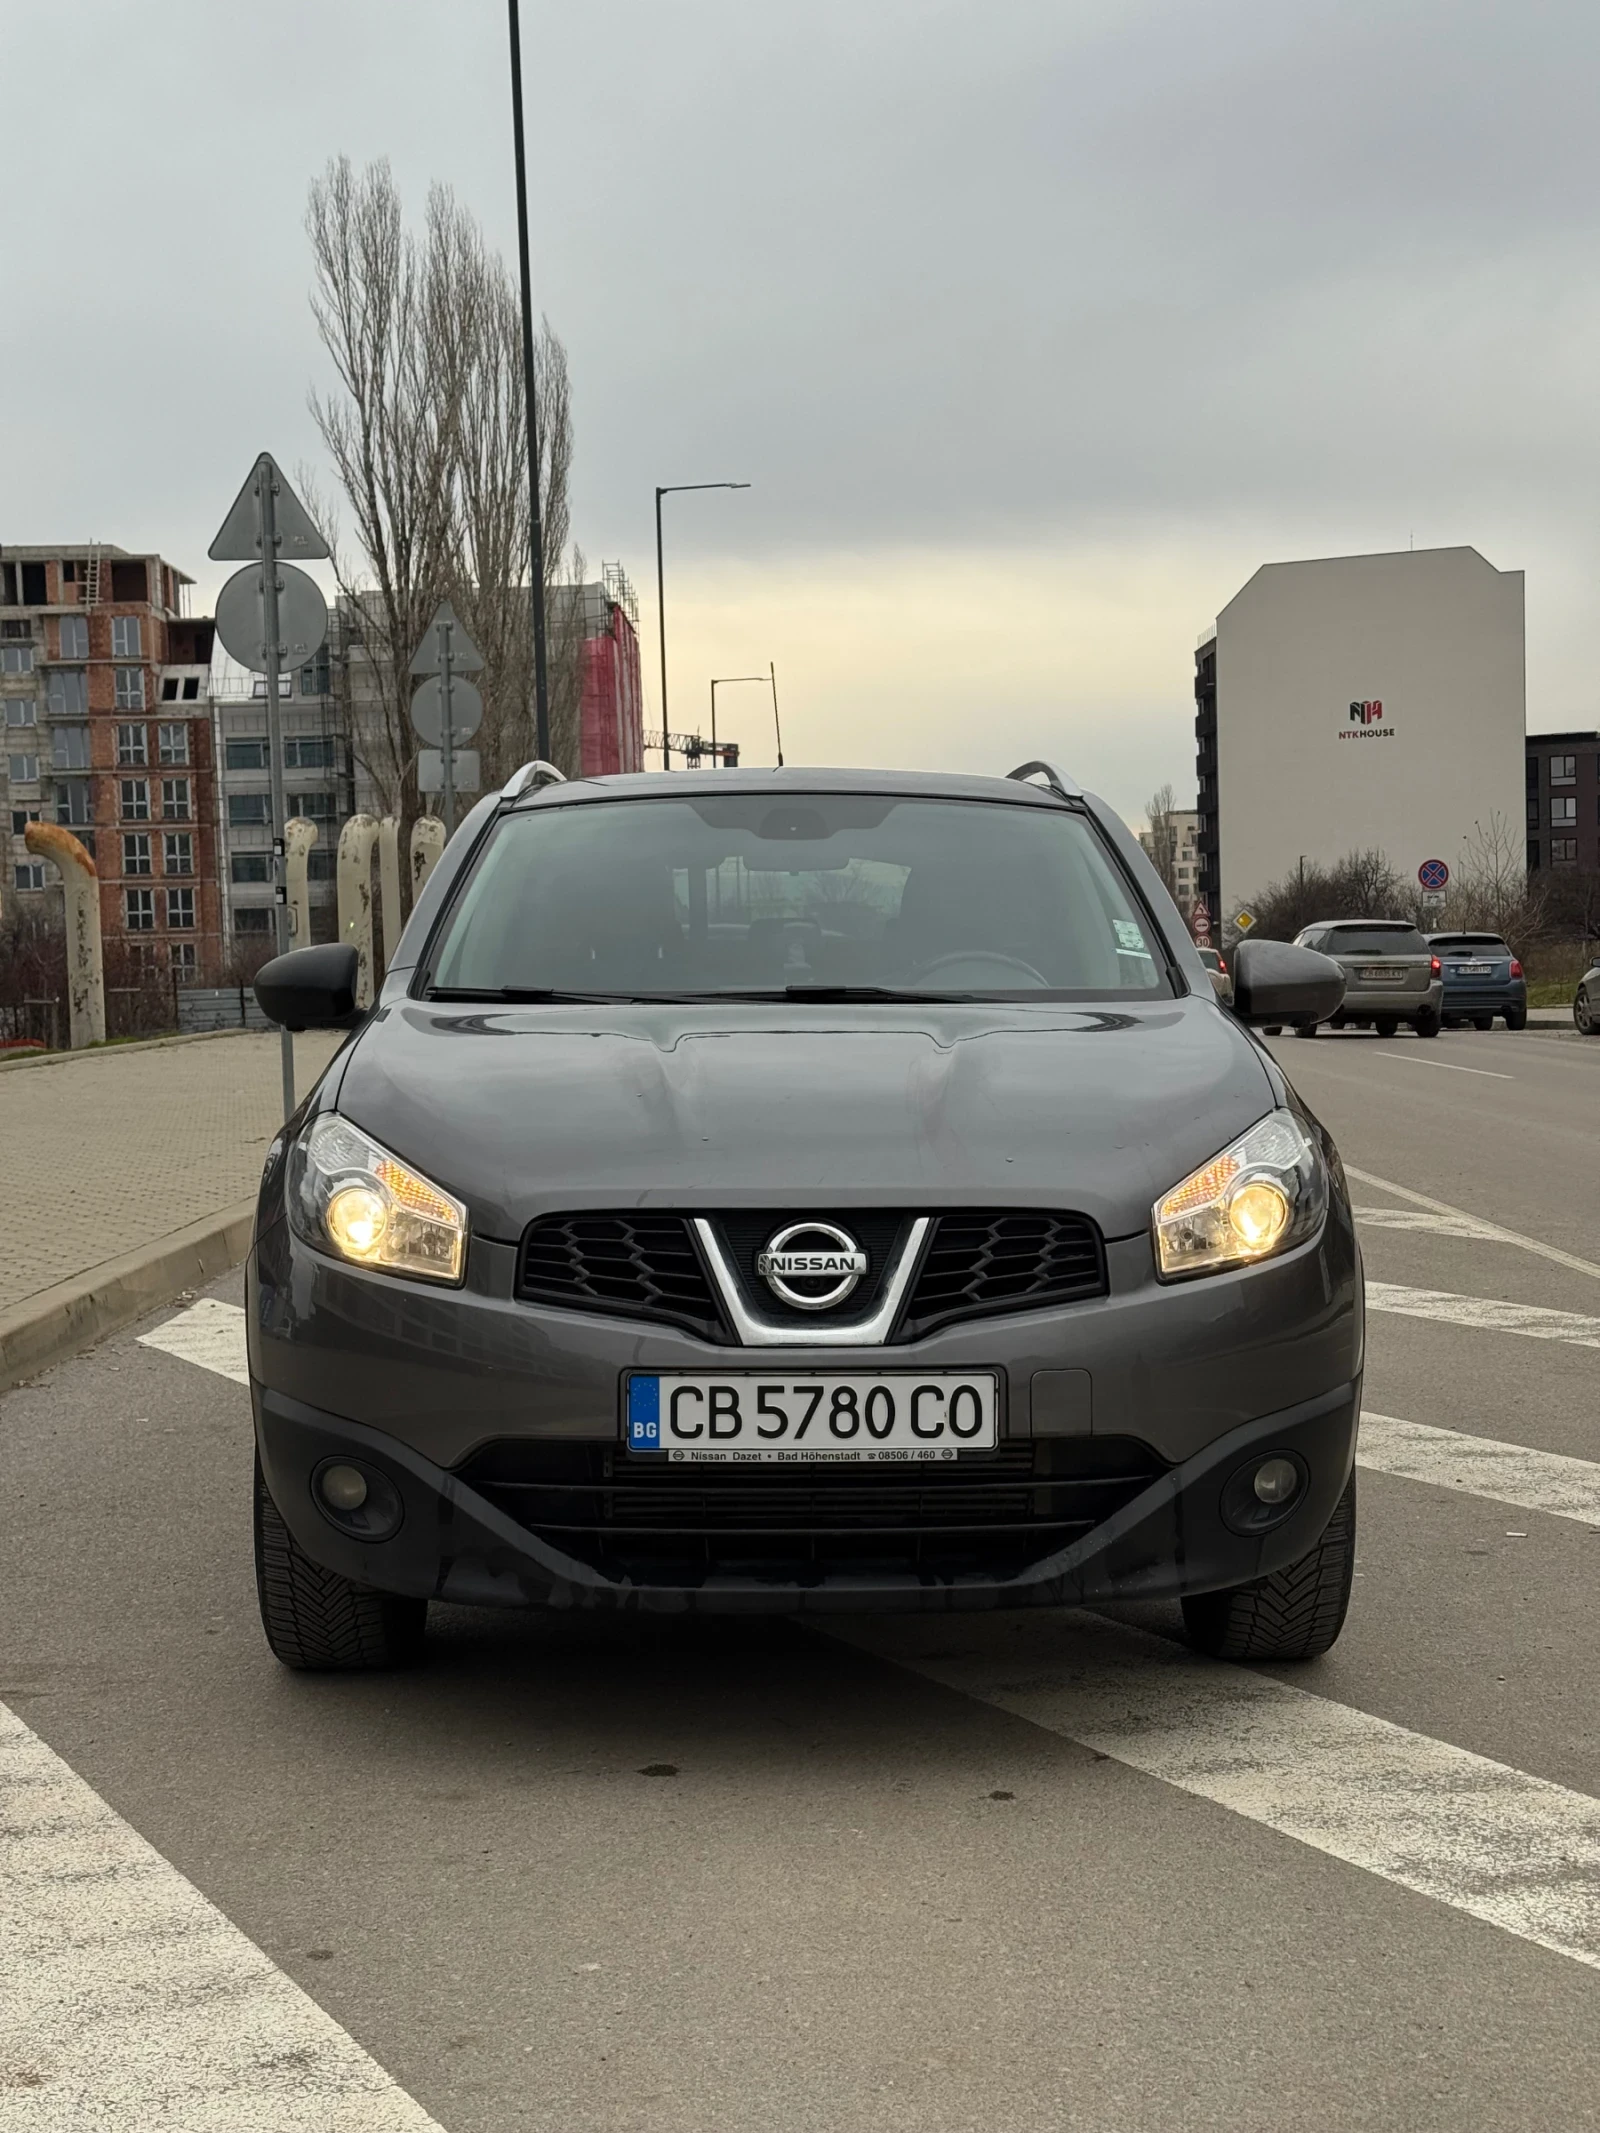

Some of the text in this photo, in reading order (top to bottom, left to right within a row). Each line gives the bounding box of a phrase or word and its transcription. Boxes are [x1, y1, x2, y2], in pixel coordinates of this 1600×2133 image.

[1197, 938, 1208, 947] 30
[770, 1257, 855, 1271] NISSAN
[670, 1385, 982, 1440] CB 5780 CO
[633, 1422, 657, 1439] BG
[690, 1451, 727, 1461] Nissan
[732, 1451, 762, 1461] Dazet
[777, 1451, 798, 1461] Bad
[801, 1450, 860, 1461] Höhenstadt
[878, 1450, 908, 1460] 08506
[917, 1450, 936, 1460] 460
